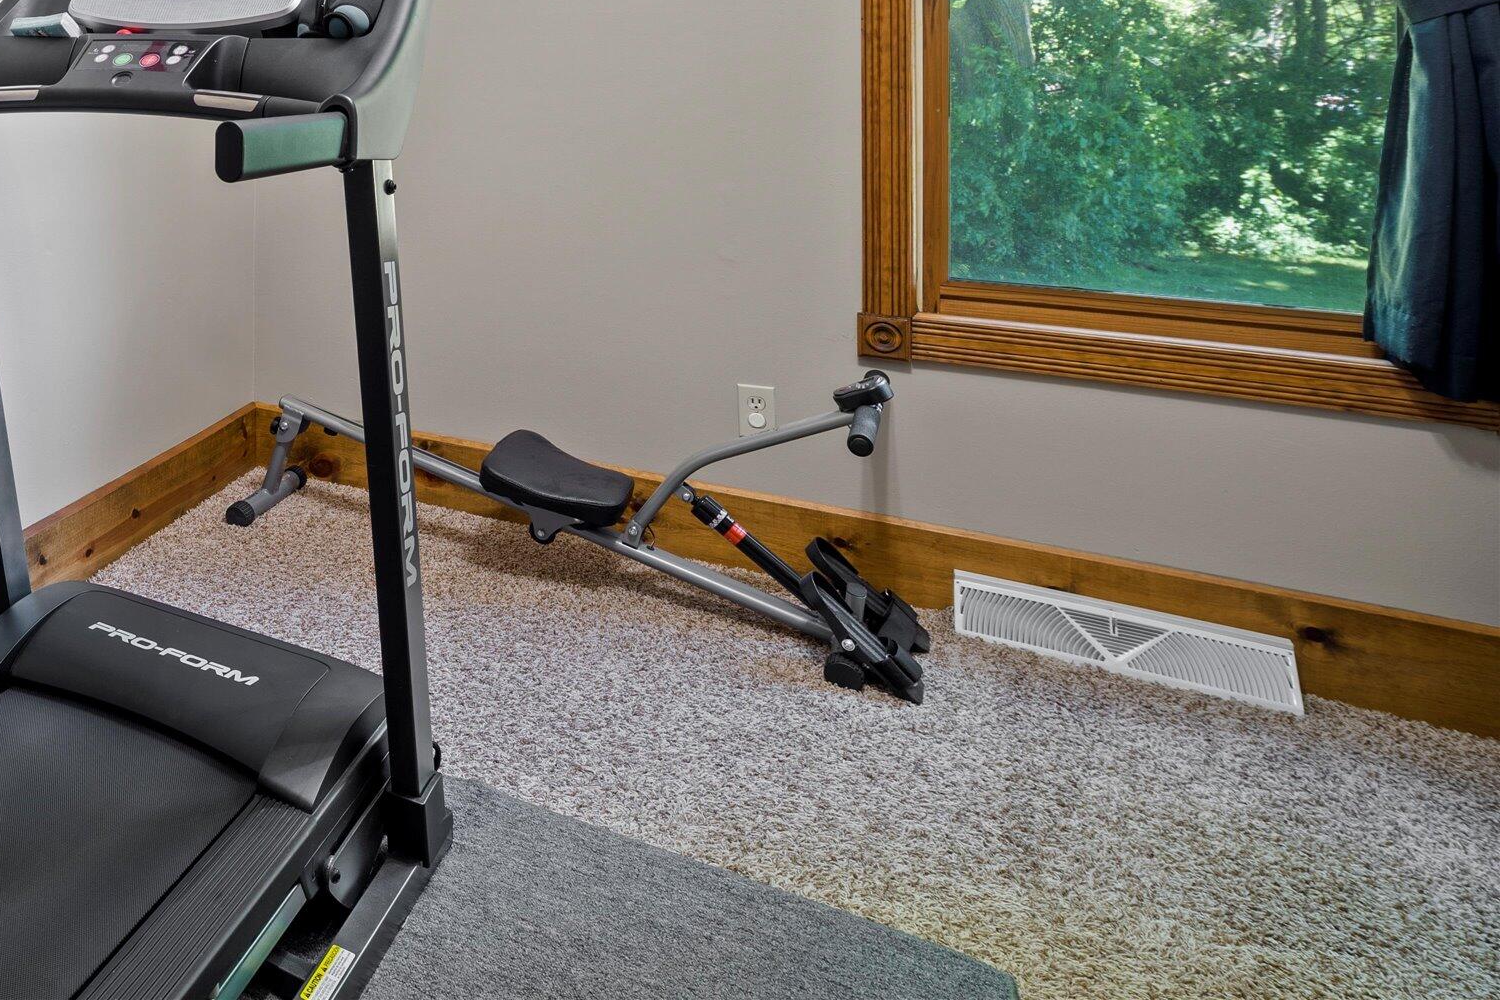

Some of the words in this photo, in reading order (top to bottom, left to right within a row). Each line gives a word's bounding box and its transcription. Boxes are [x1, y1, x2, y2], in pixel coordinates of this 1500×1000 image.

[384, 260, 418, 588] PRO-FORM
[88, 621, 260, 686] PRO-FORM
[306, 973, 323, 993] CAUTION
